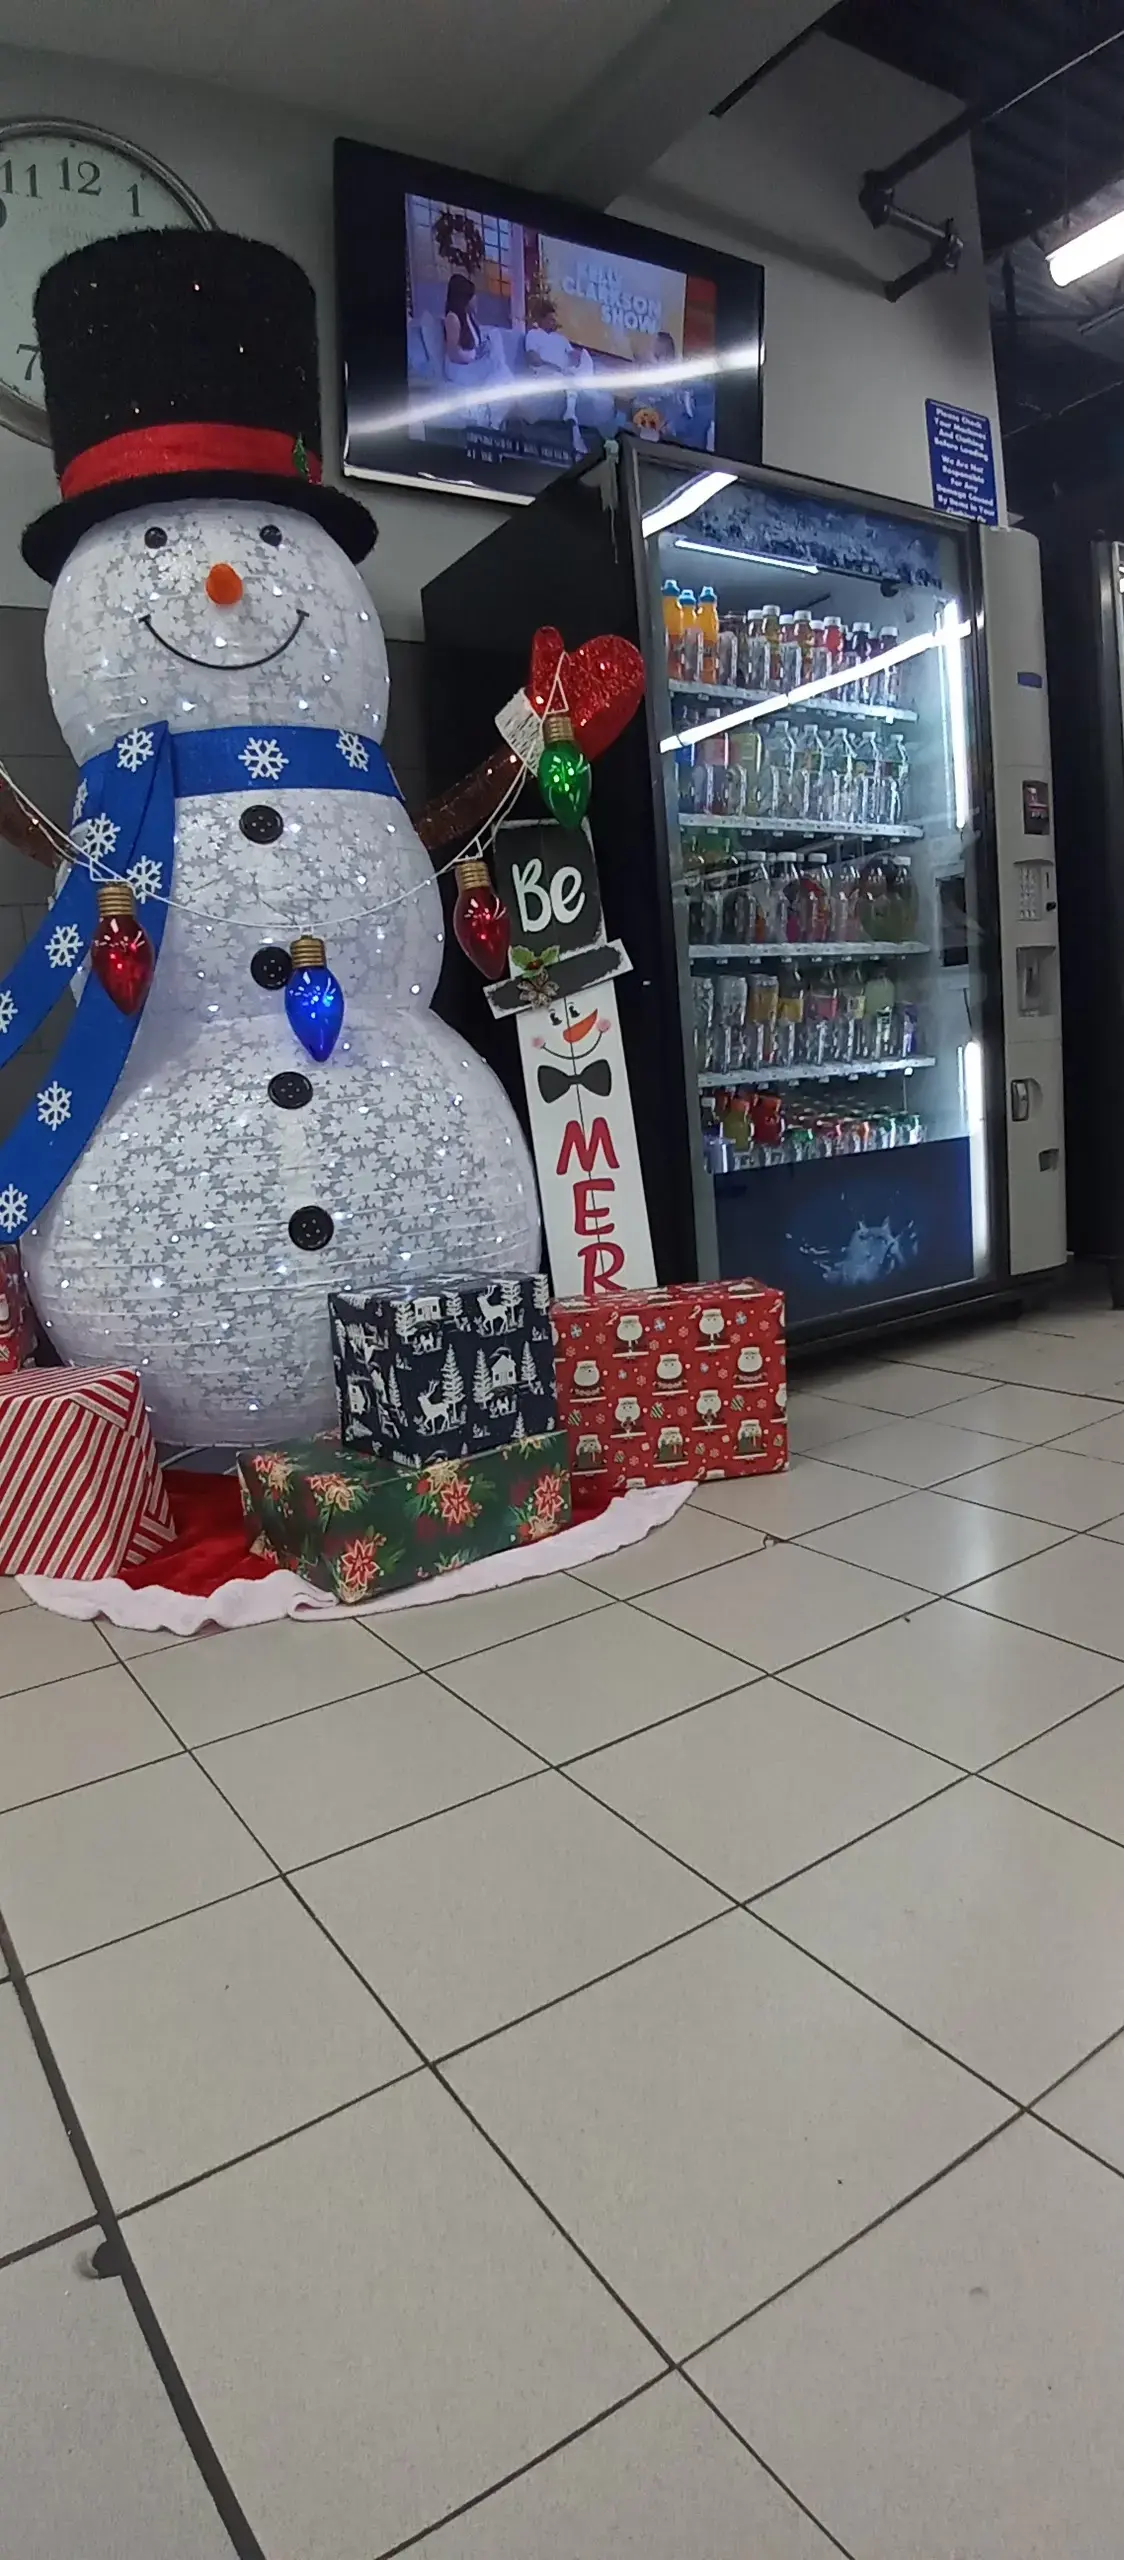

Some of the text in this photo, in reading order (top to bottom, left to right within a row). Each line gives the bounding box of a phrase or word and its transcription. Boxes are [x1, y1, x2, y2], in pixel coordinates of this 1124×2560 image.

[0, 159, 42, 199] 11
[57, 157, 102, 196] 12
[127, 183, 144, 217] 1
[562, 275, 662, 317] CLARKSON
[601, 304, 657, 335] SHOW
[16, 343, 40, 381] 7
[934, 417, 986, 440] Your Machines
[936, 407, 982, 429] Please Check
[934, 437, 989, 462] Before Loading
[939, 429, 984, 451] And Clothing
[941, 455, 984, 474] We Are Not
[942, 465, 985, 484] Responsible
[936, 483, 994, 506] Damage Caused
[950, 477, 978, 493] For Any
[938, 494, 948, 505] By
[978, 505, 995, 517] Your
[512, 857, 586, 933] Be
